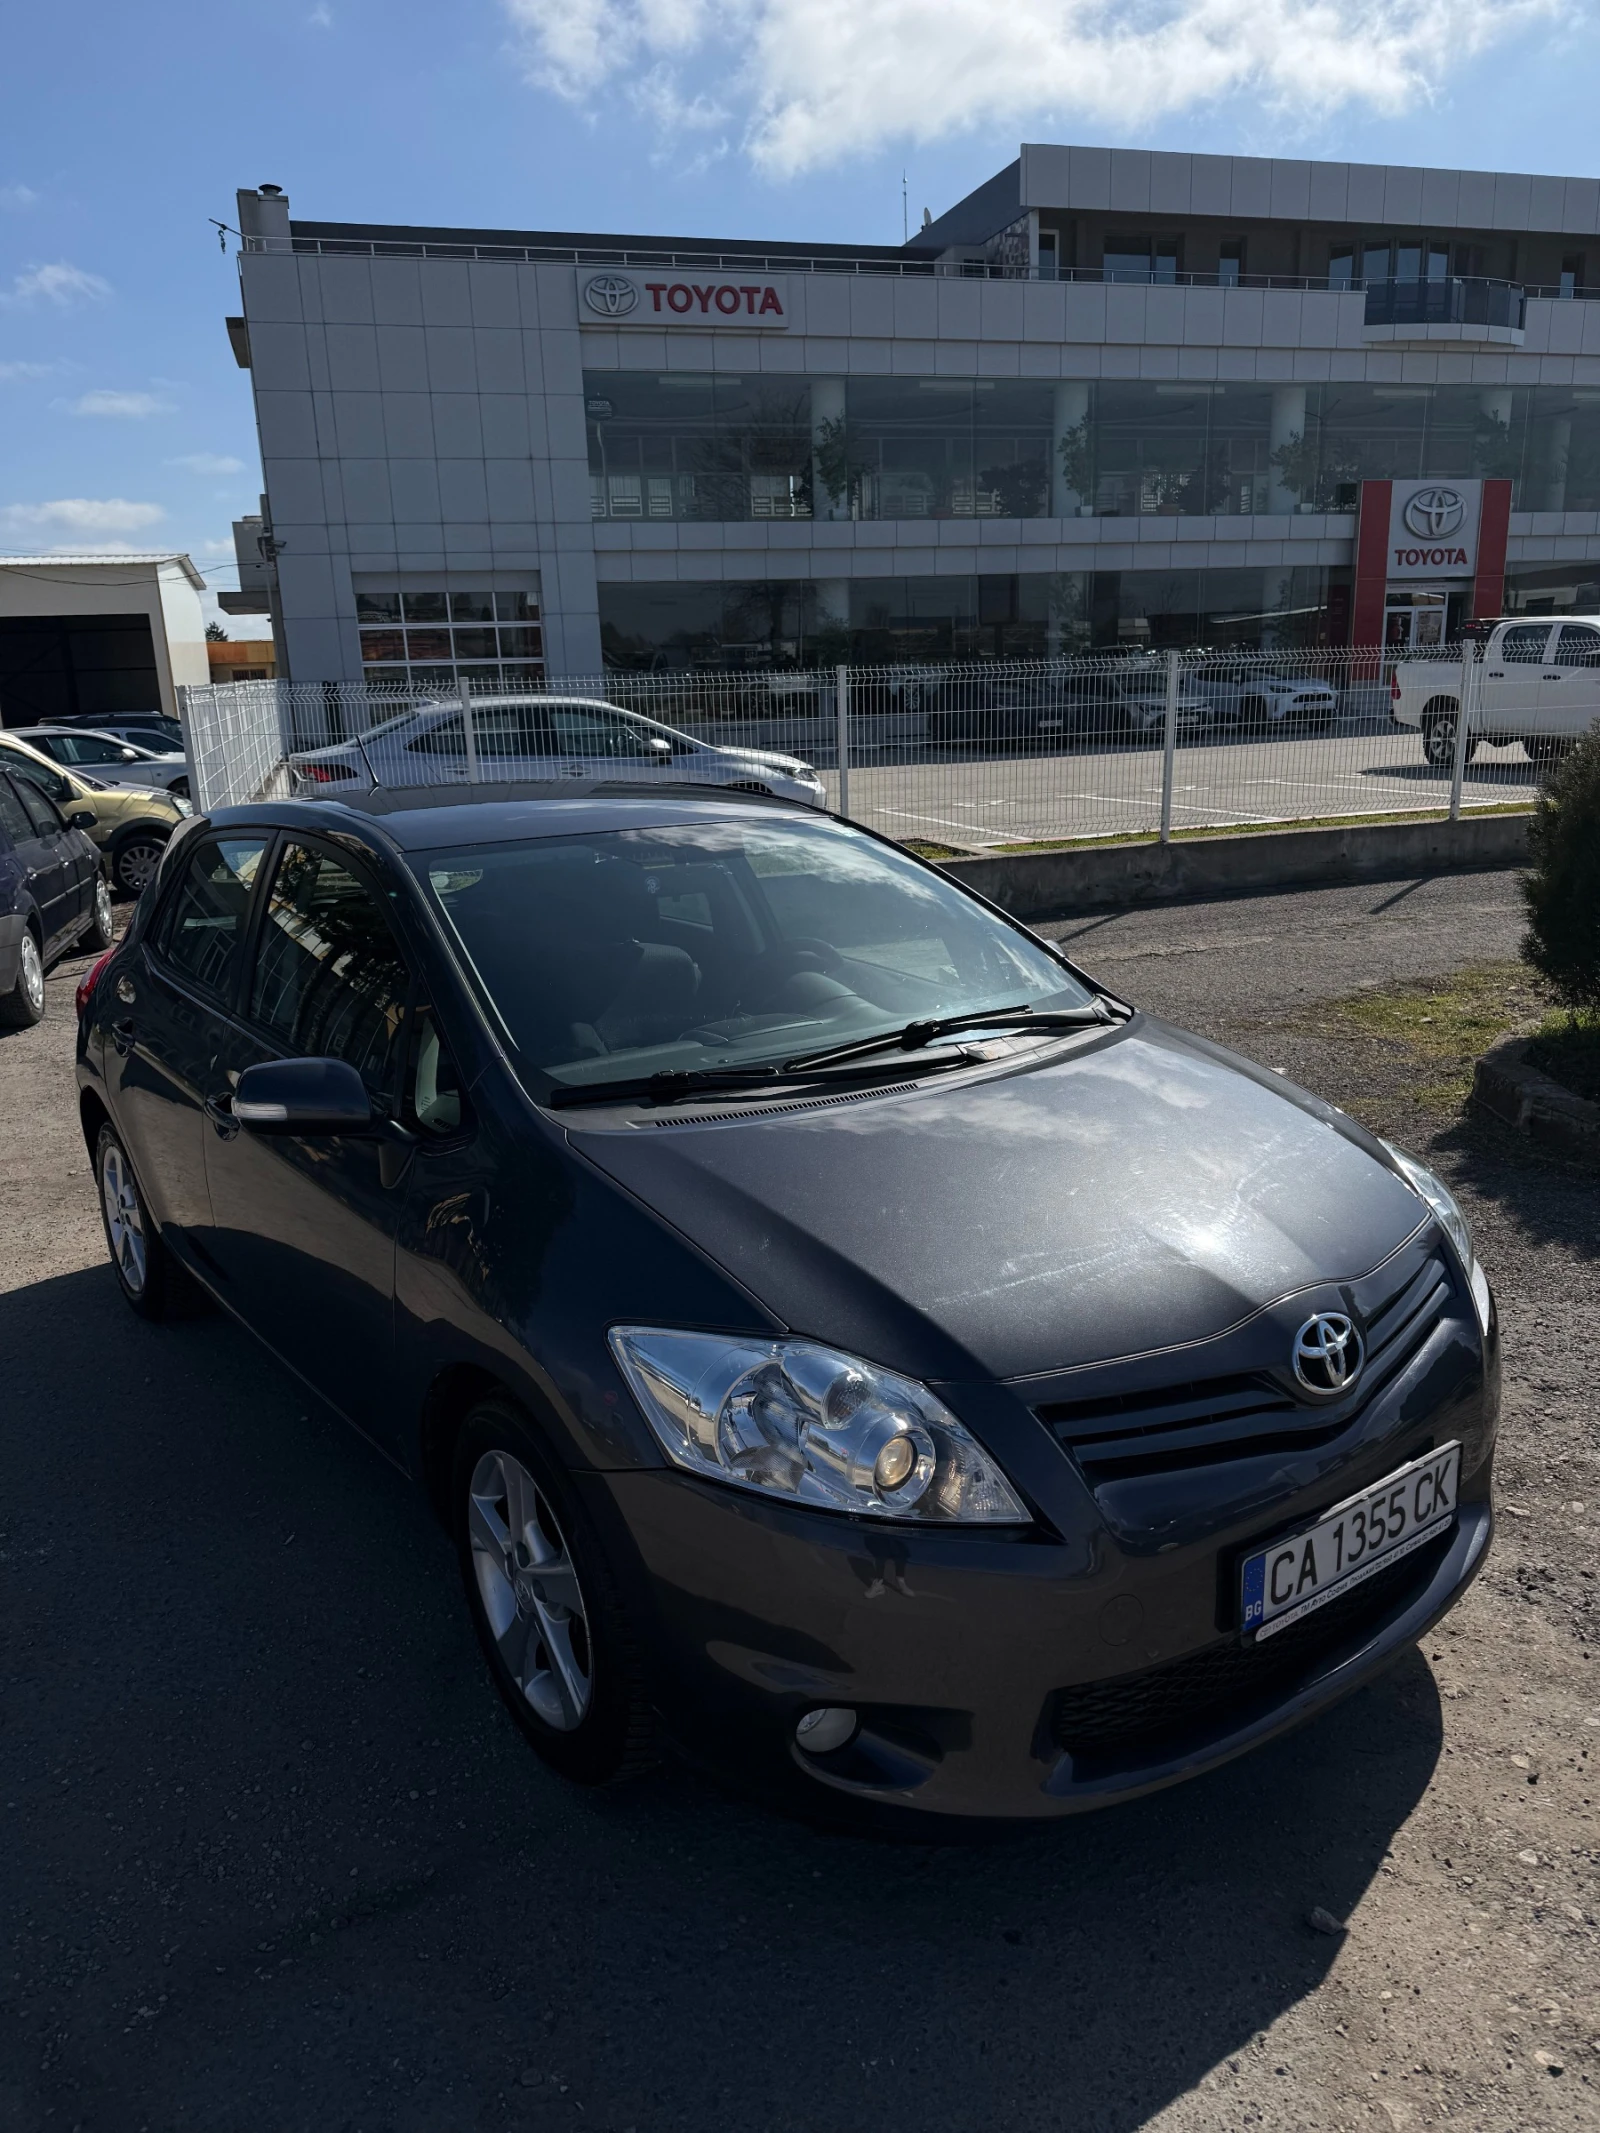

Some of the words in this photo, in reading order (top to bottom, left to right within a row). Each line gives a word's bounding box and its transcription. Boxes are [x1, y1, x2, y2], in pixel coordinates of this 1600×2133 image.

[645, 283, 784, 315] TOYOTA
[1394, 548, 1468, 566] TOYOTA
[1270, 1539, 1318, 1605] CA
[1333, 1486, 1406, 1572] 1355
[1414, 1458, 1452, 1523] CK
[1245, 1600, 1262, 1621] BG
